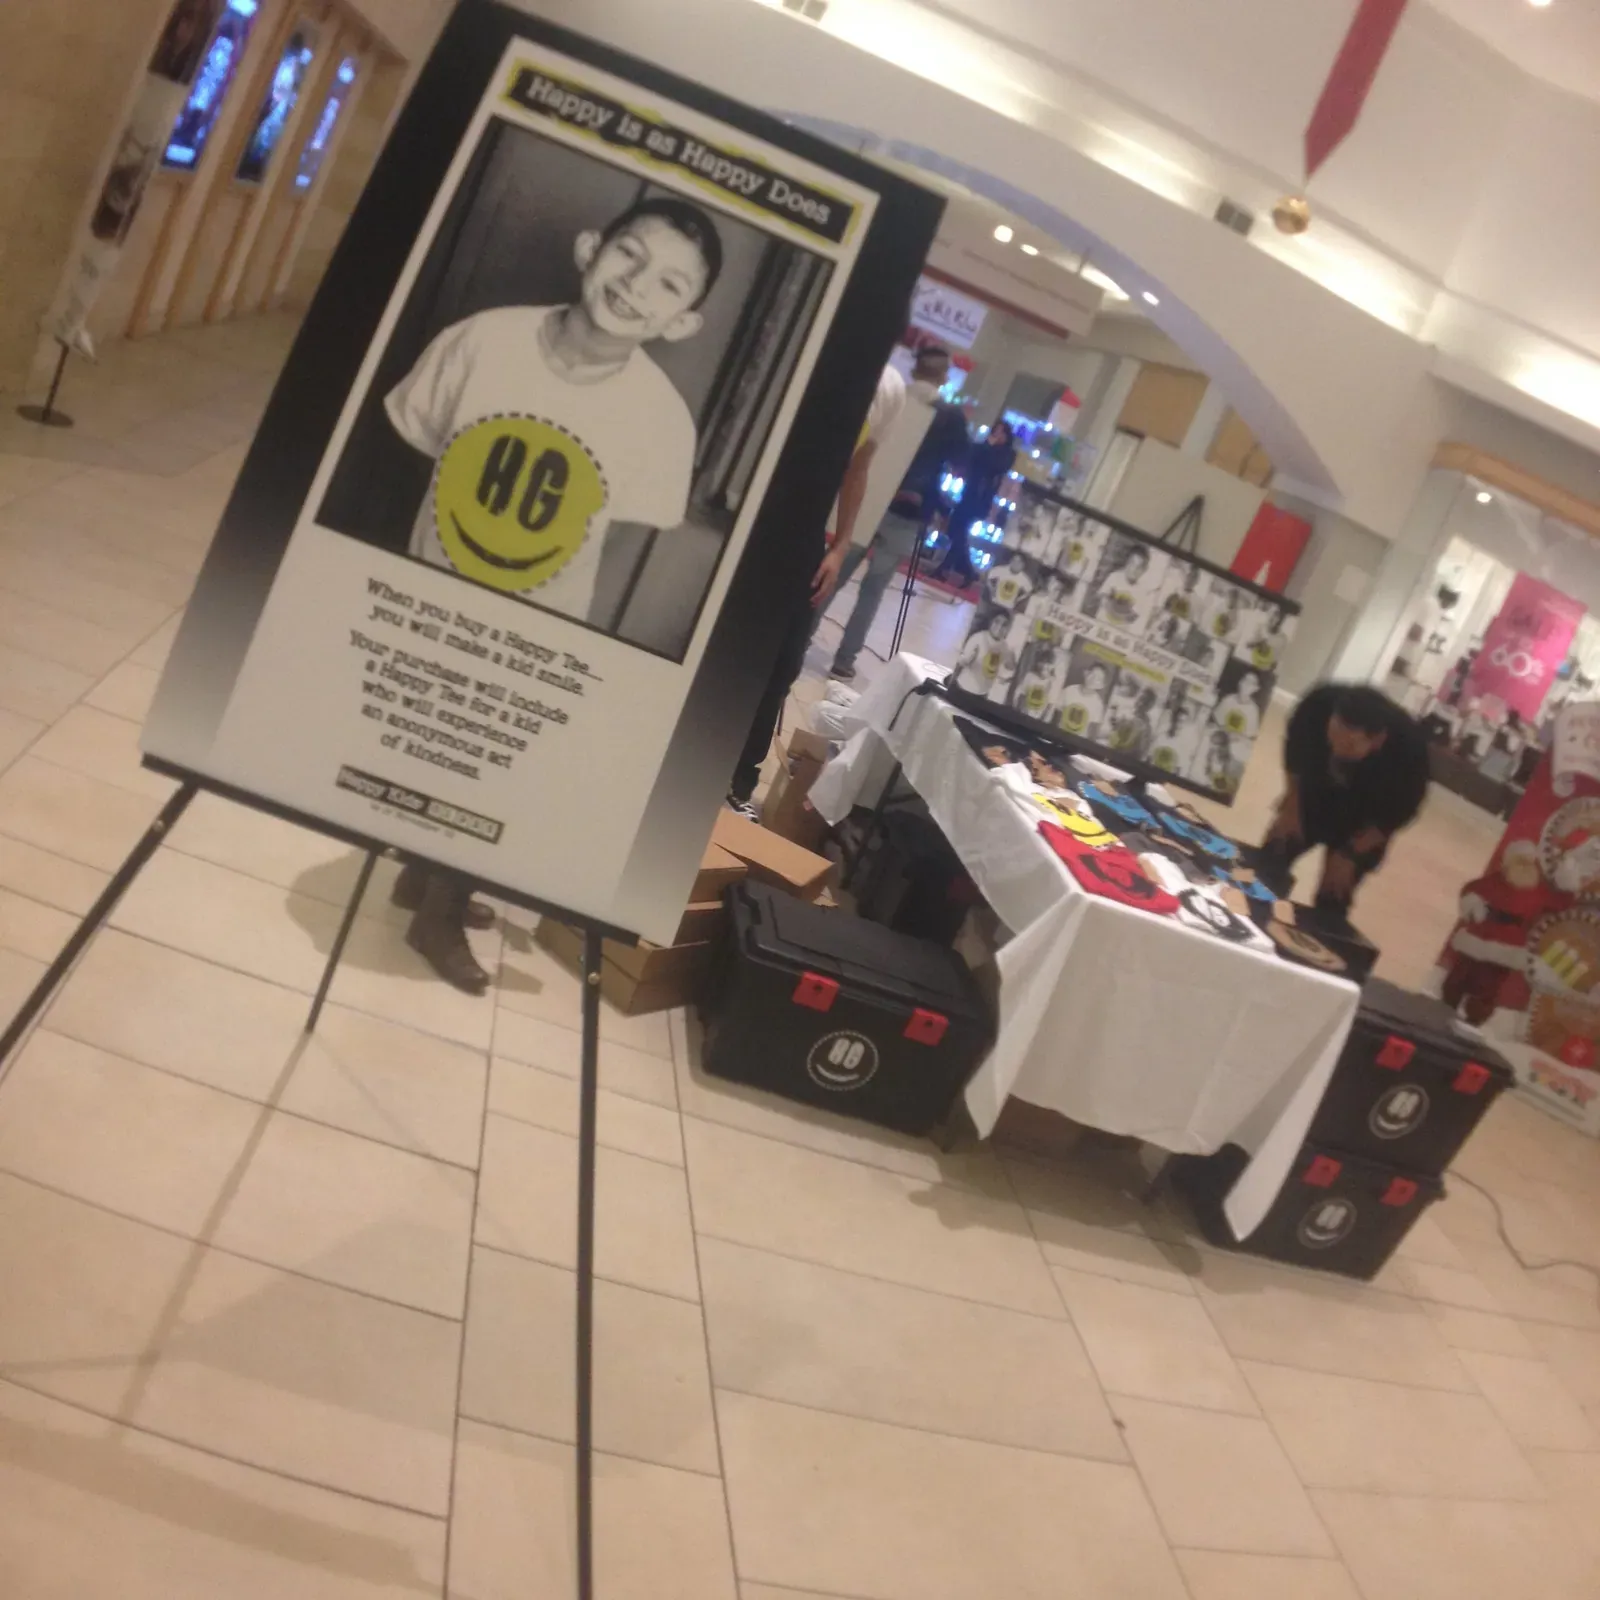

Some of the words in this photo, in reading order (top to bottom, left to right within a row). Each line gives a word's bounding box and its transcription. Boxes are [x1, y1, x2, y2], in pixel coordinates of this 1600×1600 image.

[526, 75, 613, 129] Happy
[616, 109, 641, 141] is
[645, 130, 677, 156] as
[679, 141, 767, 192] Happy
[767, 179, 830, 225] Does
[476, 433, 569, 533] HG
[367, 577, 414, 607] When
[414, 600, 450, 623] you
[453, 613, 489, 640] buy
[489, 626, 500, 641] a
[503, 630, 559, 665] Happy
[367, 603, 404, 628] you
[409, 619, 443, 643] will
[444, 631, 490, 659] make
[491, 651, 503, 665] a
[505, 652, 534, 677] kid
[349, 628, 390, 656] Your
[391, 648, 470, 688] purchase
[473, 678, 507, 702] will
[508, 691, 569, 725] include
[364, 659, 376, 674] a
[378, 661, 434, 695] Happy
[438, 682, 466, 706] Tee
[469, 696, 497, 718] for
[498, 709, 510, 724] a
[512, 711, 543, 736] kid
[361, 679, 397, 703] who
[401, 693, 434, 718] will
[436, 708, 528, 752] experience
[361, 702, 384, 722] an
[386, 711, 484, 758] anonymous
[487, 749, 513, 770] act
[380, 732, 402, 750] of
